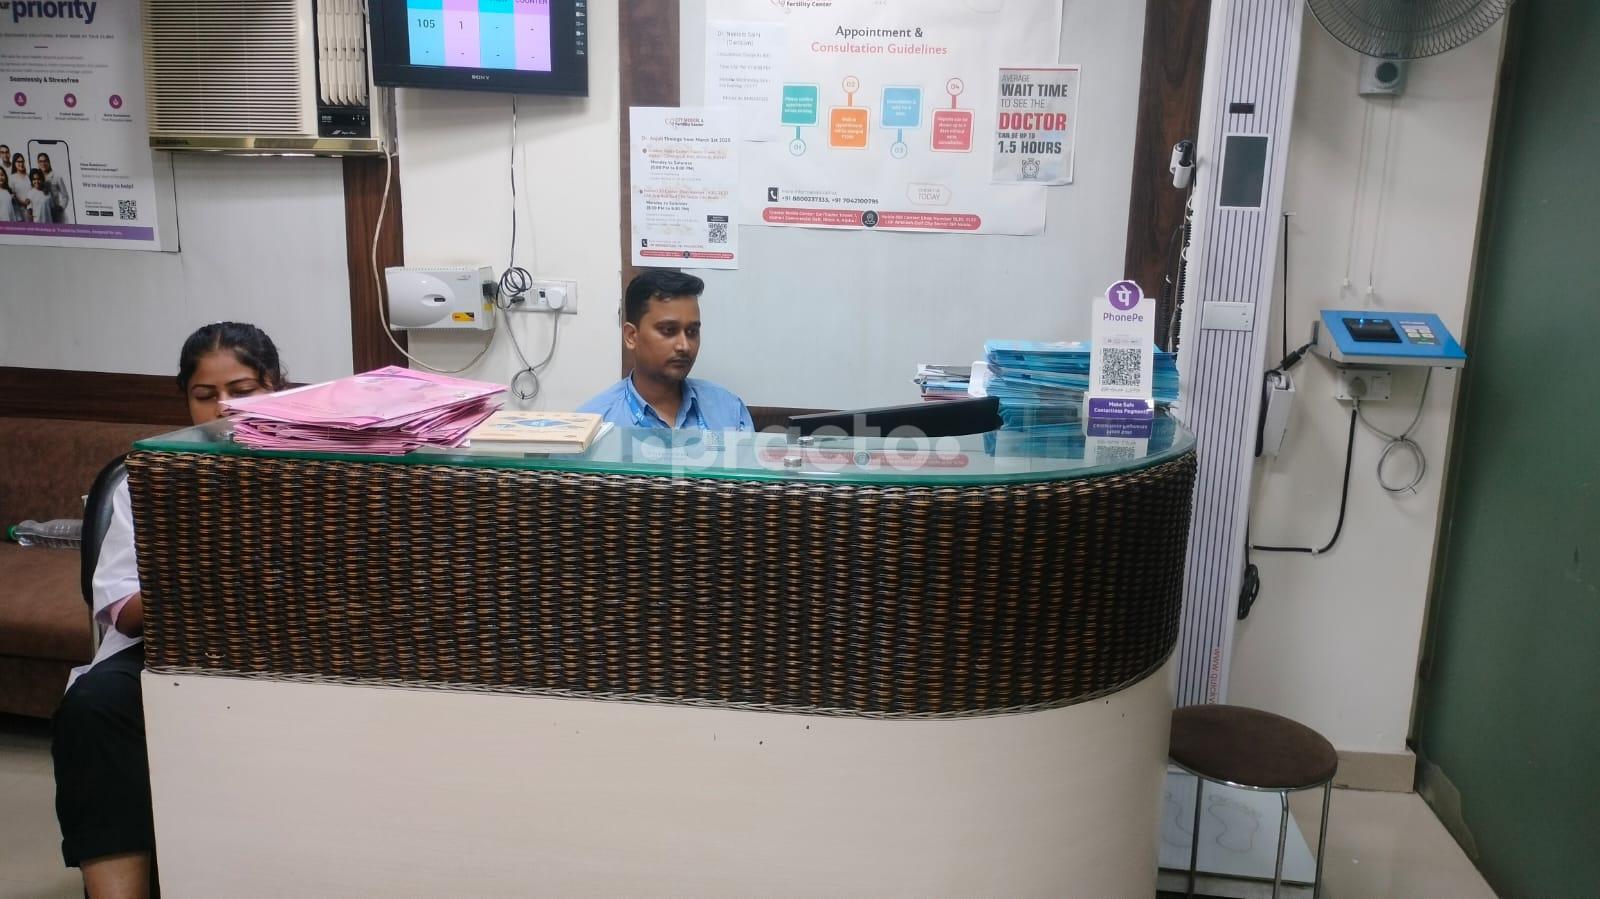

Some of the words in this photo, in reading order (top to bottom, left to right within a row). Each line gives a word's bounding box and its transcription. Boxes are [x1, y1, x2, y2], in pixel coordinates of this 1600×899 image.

[12, 0, 97, 25] priority
[417, 18, 436, 29] 105
[458, 20, 464, 30] 1
[835, 25, 912, 39] Appointment
[914, 27, 924, 38] &
[810, 42, 884, 54] Consultation
[887, 43, 948, 56] Guidelines
[1001, 74, 1031, 83] AVERAGE
[1001, 83, 1034, 97] WAIT
[1038, 84, 1068, 97] TIME
[1000, 98, 1011, 108] TO
[1013, 98, 1028, 109] SEE
[1030, 99, 1046, 109] THE
[998, 112, 1067, 131] DOCTOR
[998, 141, 1017, 154] 1.5
[1021, 141, 1062, 154] HOURS
[1103, 312, 1144, 323] PhonePe
[1123, 407, 1149, 416] Payments
